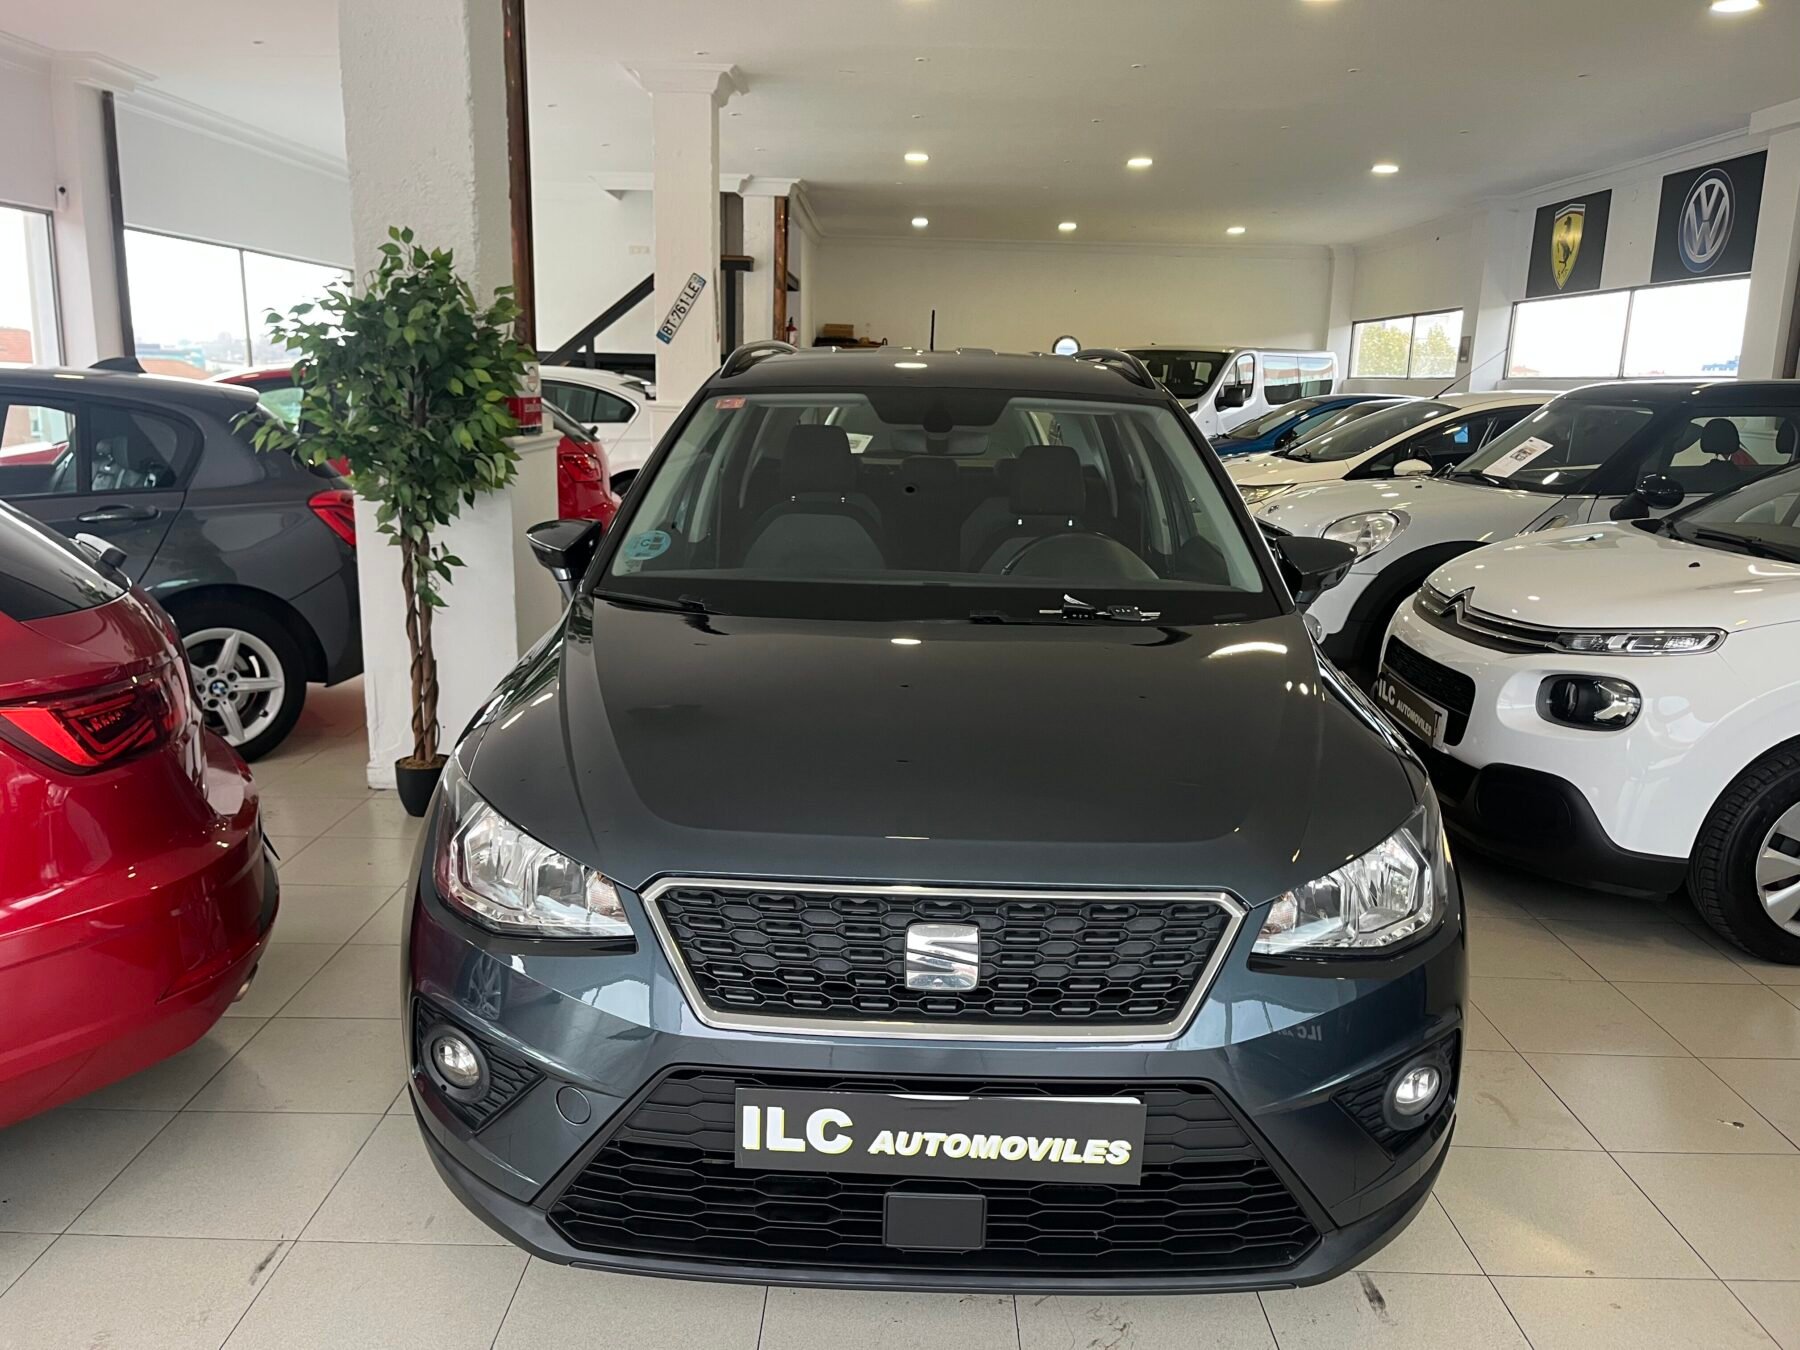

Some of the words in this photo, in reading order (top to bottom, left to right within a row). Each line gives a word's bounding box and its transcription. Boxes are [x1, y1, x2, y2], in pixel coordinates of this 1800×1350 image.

[1378, 678, 1396, 706] ILC
[1396, 700, 1432, 737] AUTOMOVILES
[742, 1105, 853, 1154] ILC
[868, 1131, 1132, 1164] AUTOMOVILES
